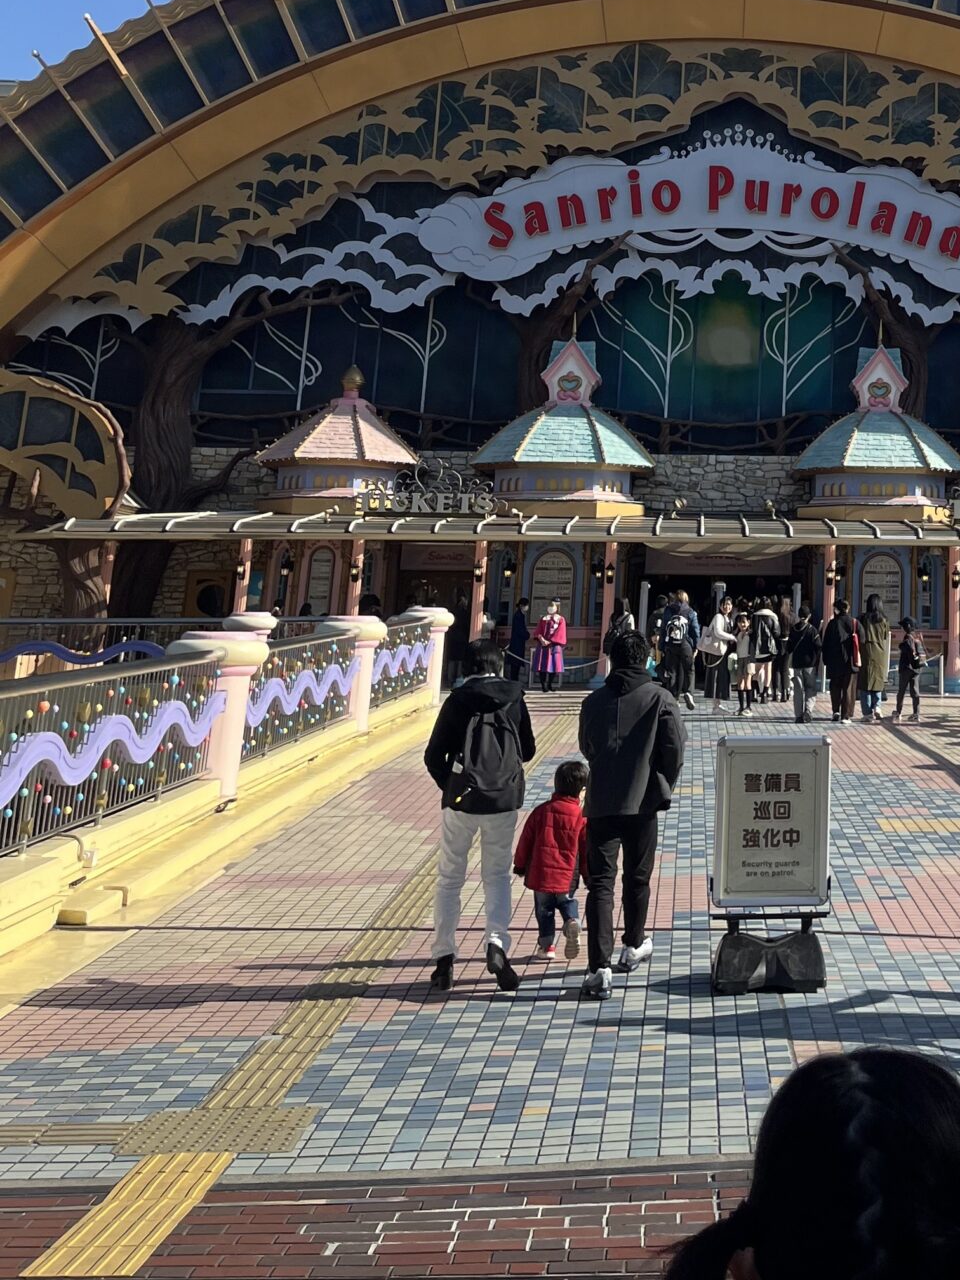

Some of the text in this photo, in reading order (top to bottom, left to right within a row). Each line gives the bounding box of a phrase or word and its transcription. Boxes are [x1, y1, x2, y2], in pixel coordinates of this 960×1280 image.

[484, 169, 682, 250] Sanrio
[361, 492, 494, 514] TICKETS
[744, 773, 802, 792] 警備員
[753, 801, 791, 820] 巡回
[742, 828, 800, 848] 強化中
[742, 860, 800, 868] Security guards
